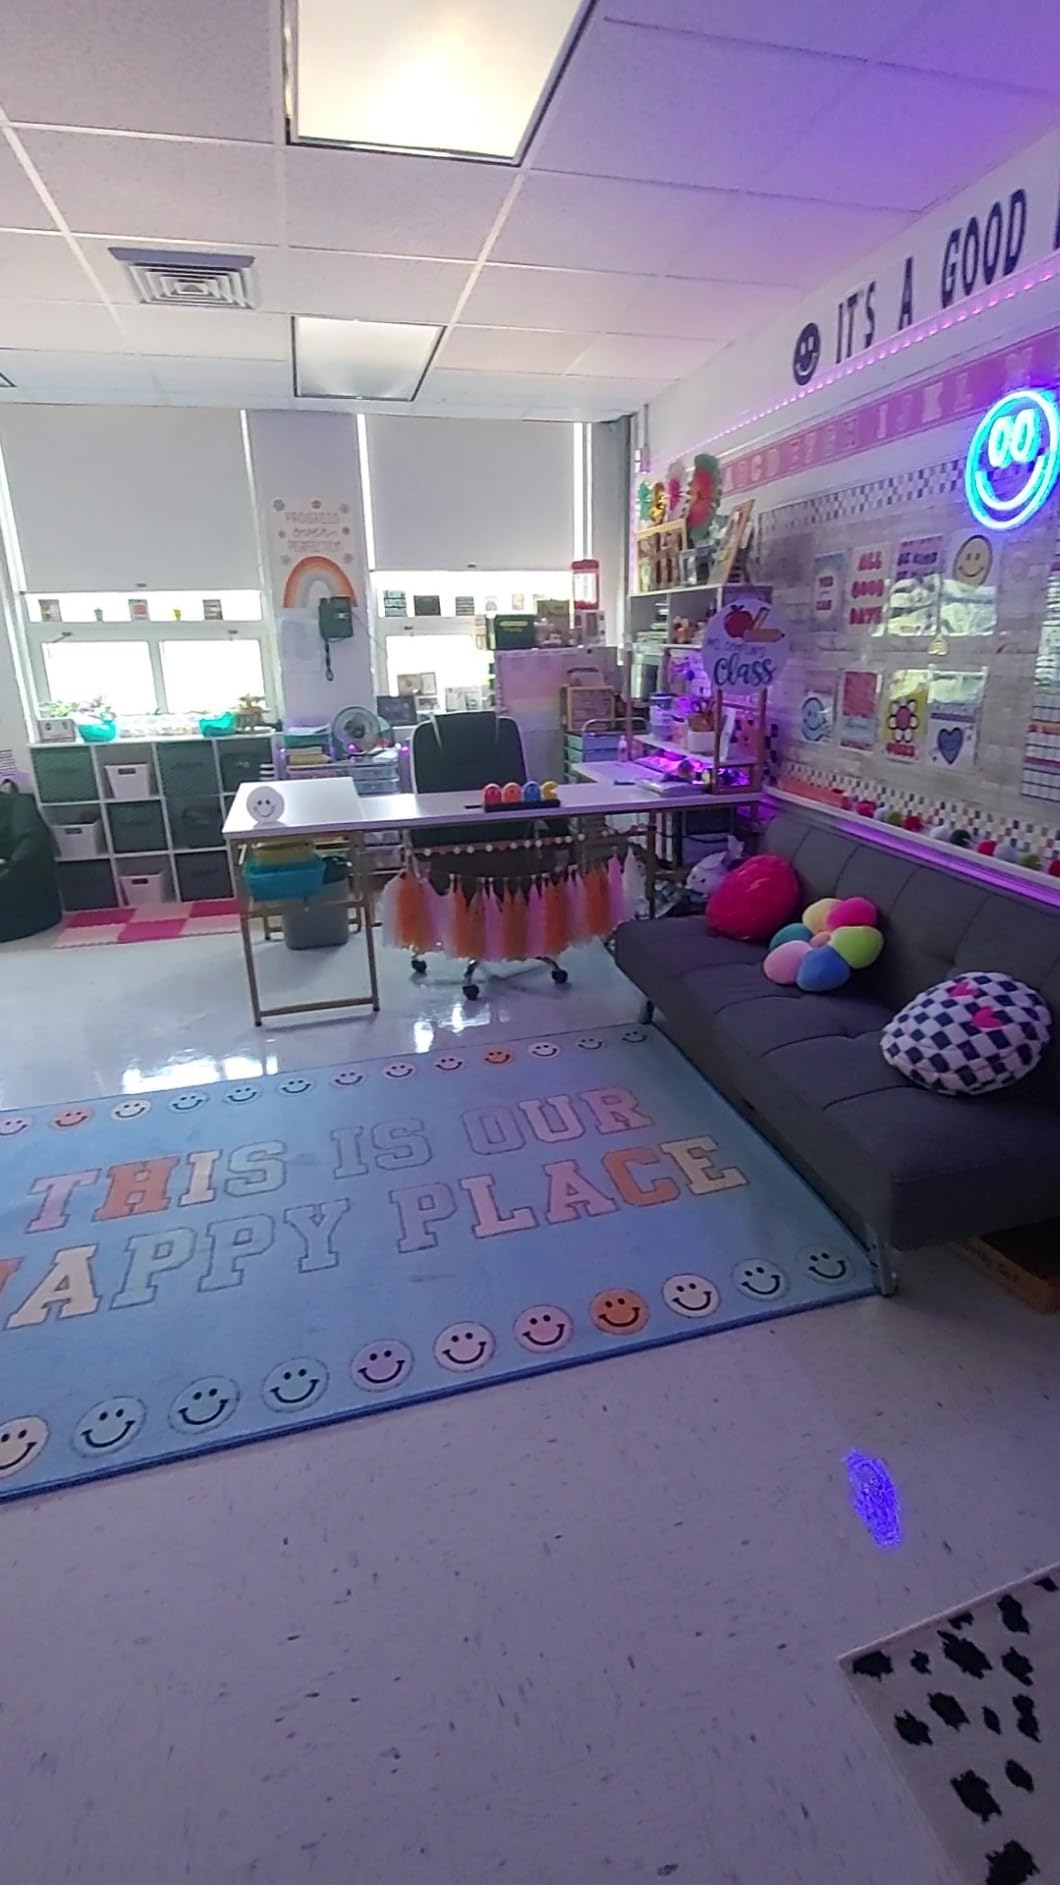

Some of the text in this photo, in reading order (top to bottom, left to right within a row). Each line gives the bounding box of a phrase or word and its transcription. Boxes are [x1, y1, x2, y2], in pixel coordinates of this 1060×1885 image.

[836, 281, 876, 364] IT'S
[898, 256, 913, 331] A
[942, 188, 1027, 309] GOOD
[713, 653, 777, 687] Class
[25, 1086, 656, 1235] THIS IS OUR
[388, 1135, 751, 1254] PLACE
